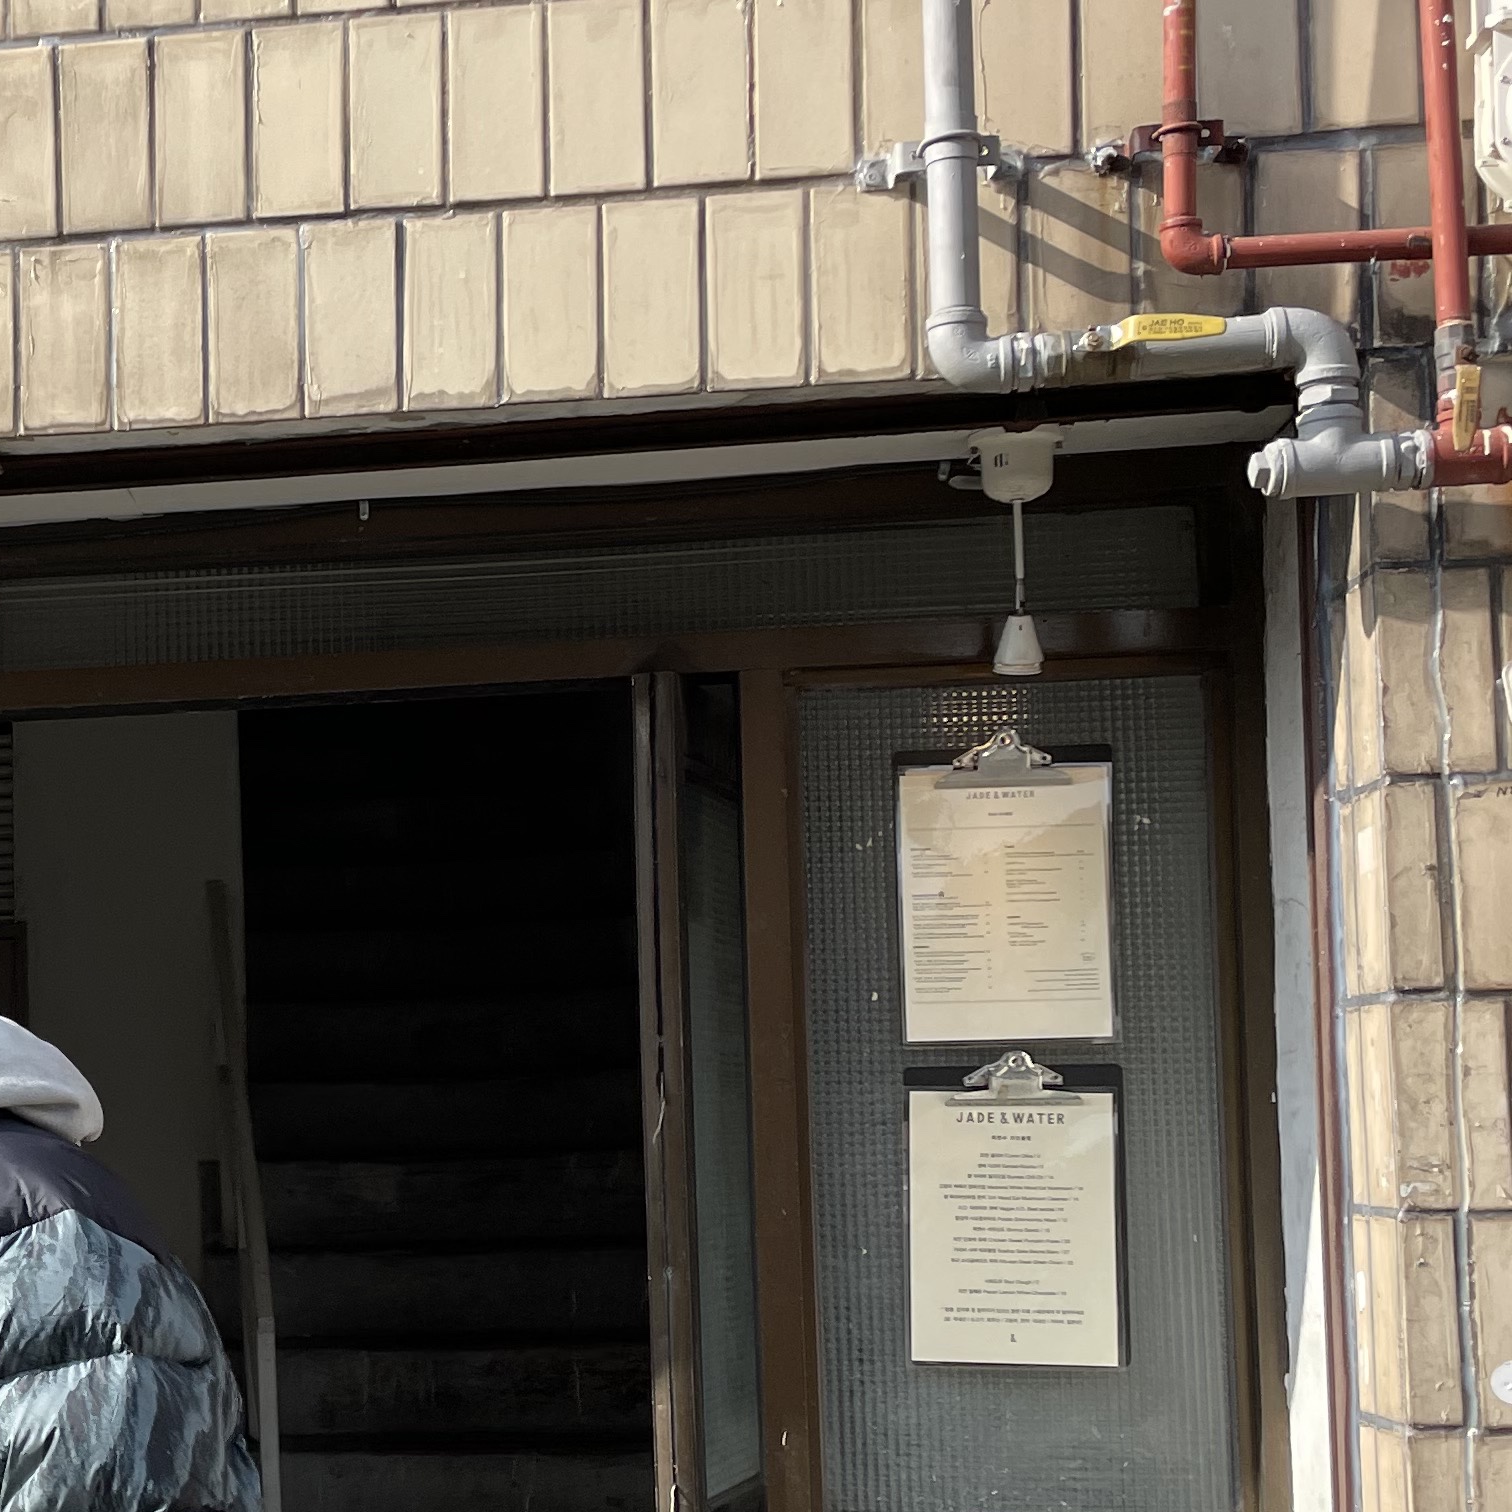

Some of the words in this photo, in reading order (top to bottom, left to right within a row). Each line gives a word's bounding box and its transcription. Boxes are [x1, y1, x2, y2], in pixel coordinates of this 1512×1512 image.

[966, 791, 991, 800] JADE
[1001, 790, 1035, 799] WATER
[956, 1112, 995, 1125] JADE
[1000, 1112, 1010, 1125] &
[1012, 1112, 1065, 1125] WATER
